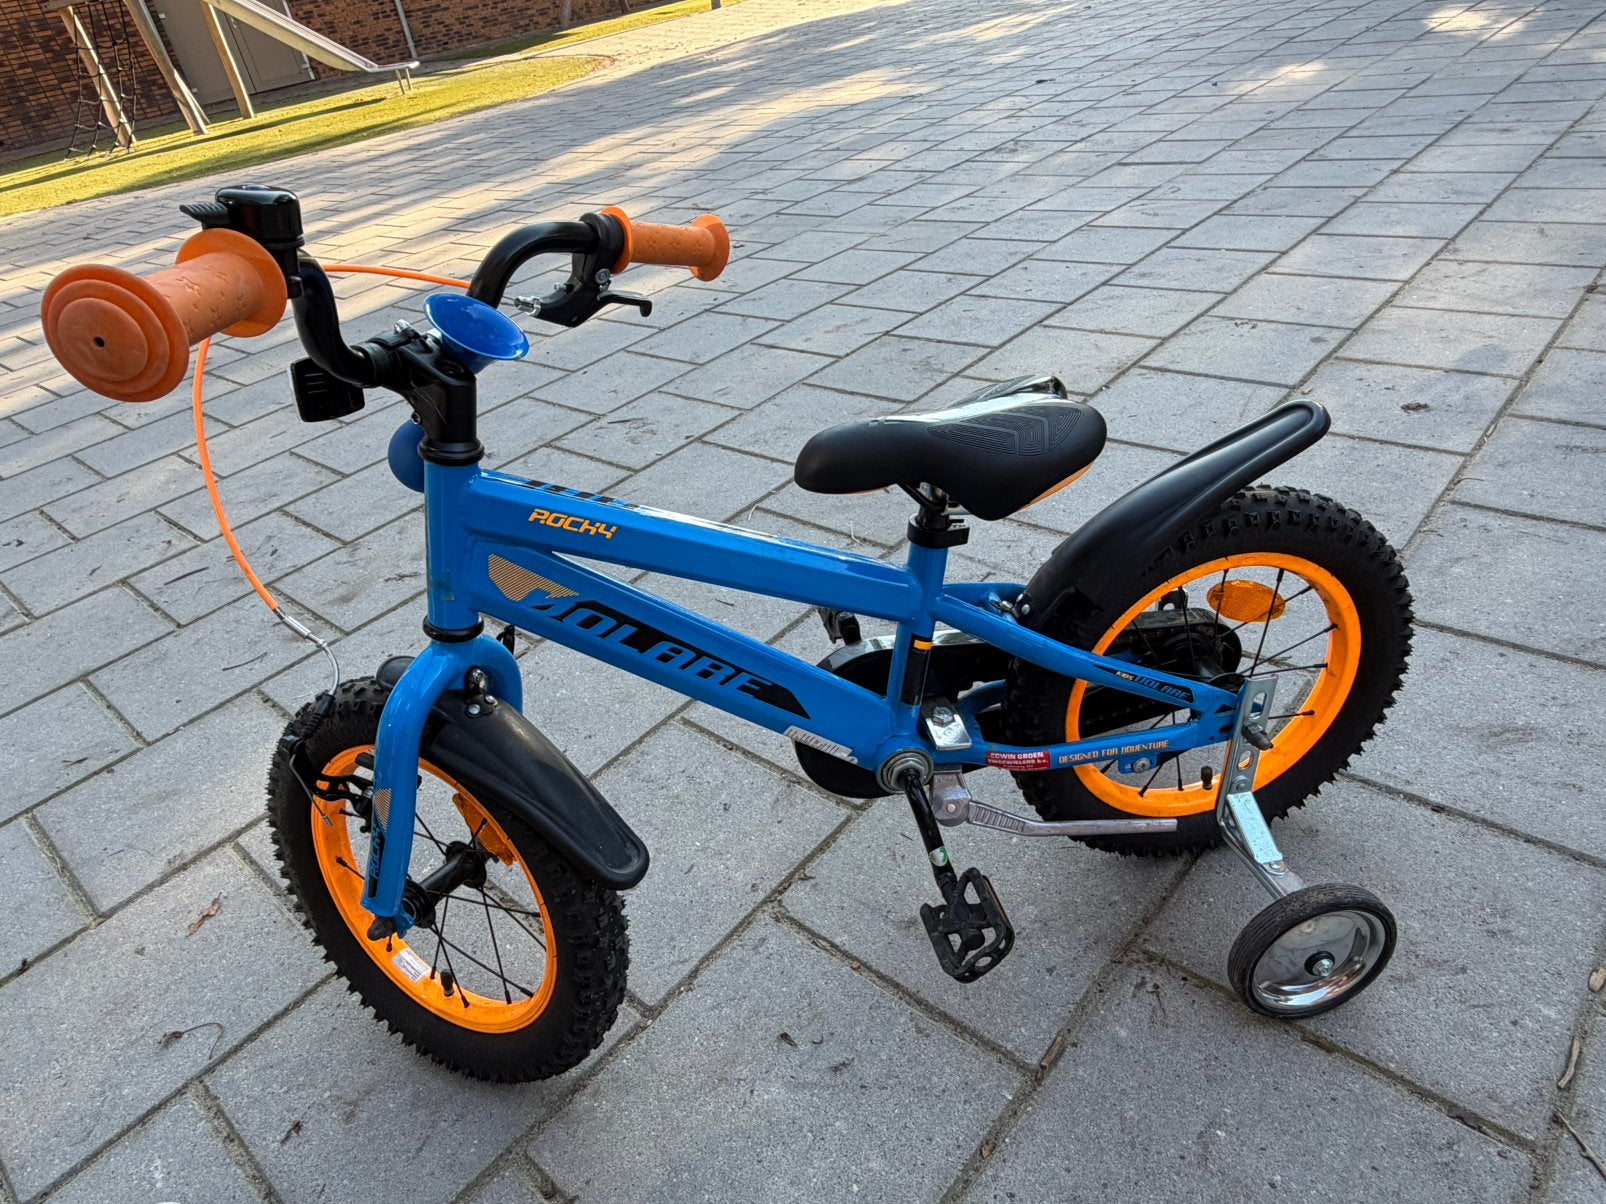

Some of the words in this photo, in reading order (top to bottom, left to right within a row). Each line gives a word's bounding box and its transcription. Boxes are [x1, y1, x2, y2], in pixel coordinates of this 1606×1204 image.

[528, 508, 618, 539] ROCKY
[990, 752, 1016, 760] EDWIN
[1017, 751, 1044, 760] GROEN
[1058, 750, 1099, 764] DESIGNED
[1101, 747, 1119, 758] FOR
[1120, 739, 1169, 755] ADVENTURE
